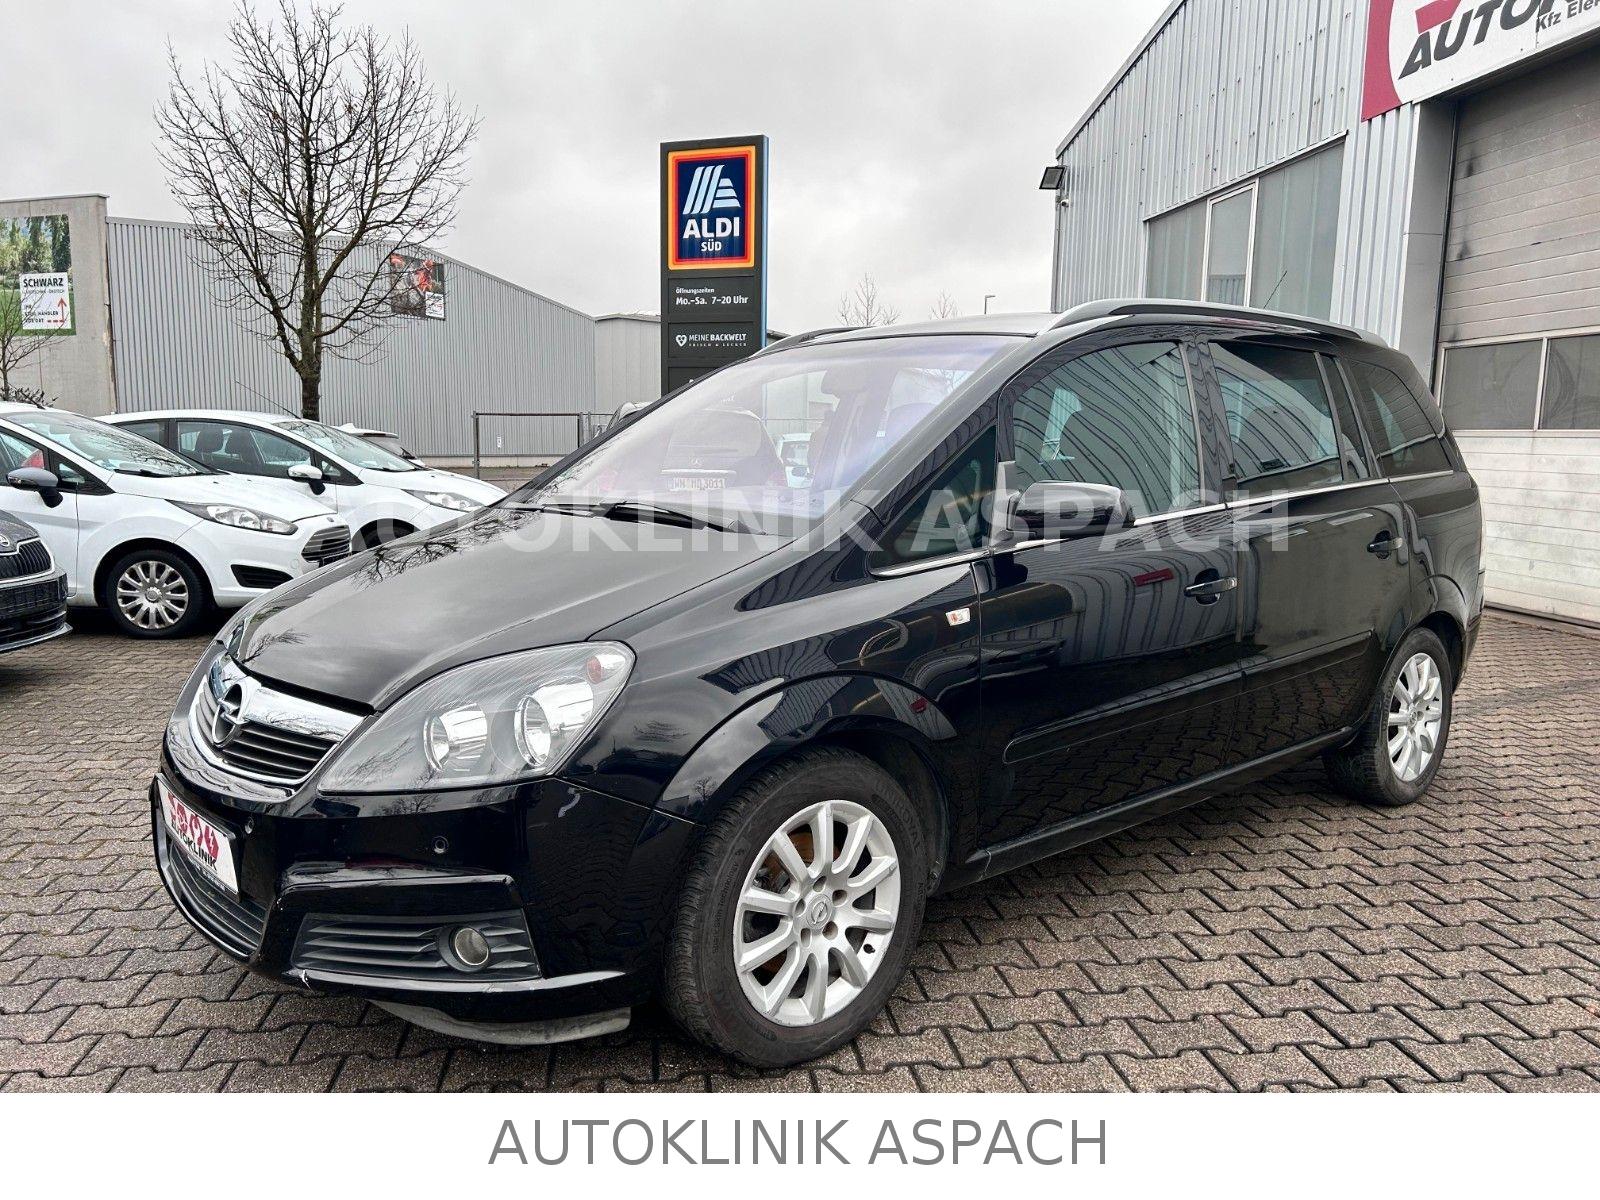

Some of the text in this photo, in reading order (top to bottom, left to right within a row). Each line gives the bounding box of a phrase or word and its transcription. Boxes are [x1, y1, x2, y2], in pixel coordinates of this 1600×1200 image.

[1536, 11, 1562, 33] Kfz
[683, 217, 740, 239] ALDI
[701, 239, 722, 252] SÜD
[23, 278, 64, 287] SCHWARZ
[675, 287, 715, 295] Öffnungszeiten
[733, 295, 749, 304] Uhr
[689, 333, 747, 342] MEINE BACKWELT
